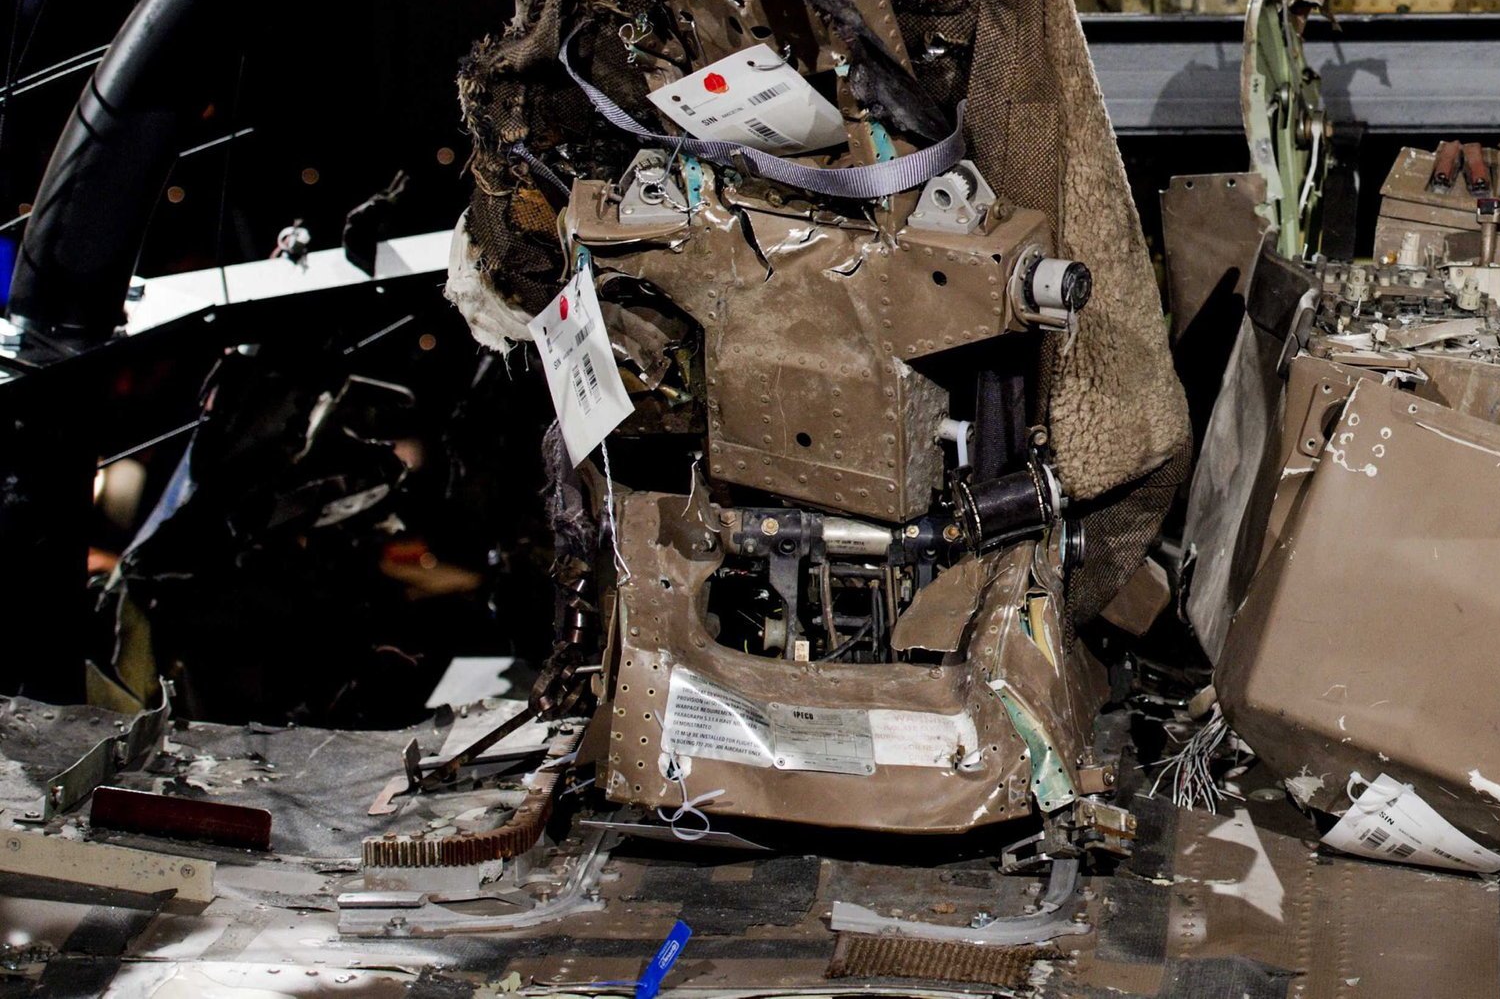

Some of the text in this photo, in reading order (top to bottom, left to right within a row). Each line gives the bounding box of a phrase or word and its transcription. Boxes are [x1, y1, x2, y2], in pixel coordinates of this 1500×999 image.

[701, 115, 718, 127] SIN
[677, 695, 702, 703] PROVISION
[793, 711, 814, 720] IPECO
[699, 733, 725, 741] INSTALLED
[723, 746, 746, 754] AIRCRAFT
[1379, 811, 1394, 825] SIN
